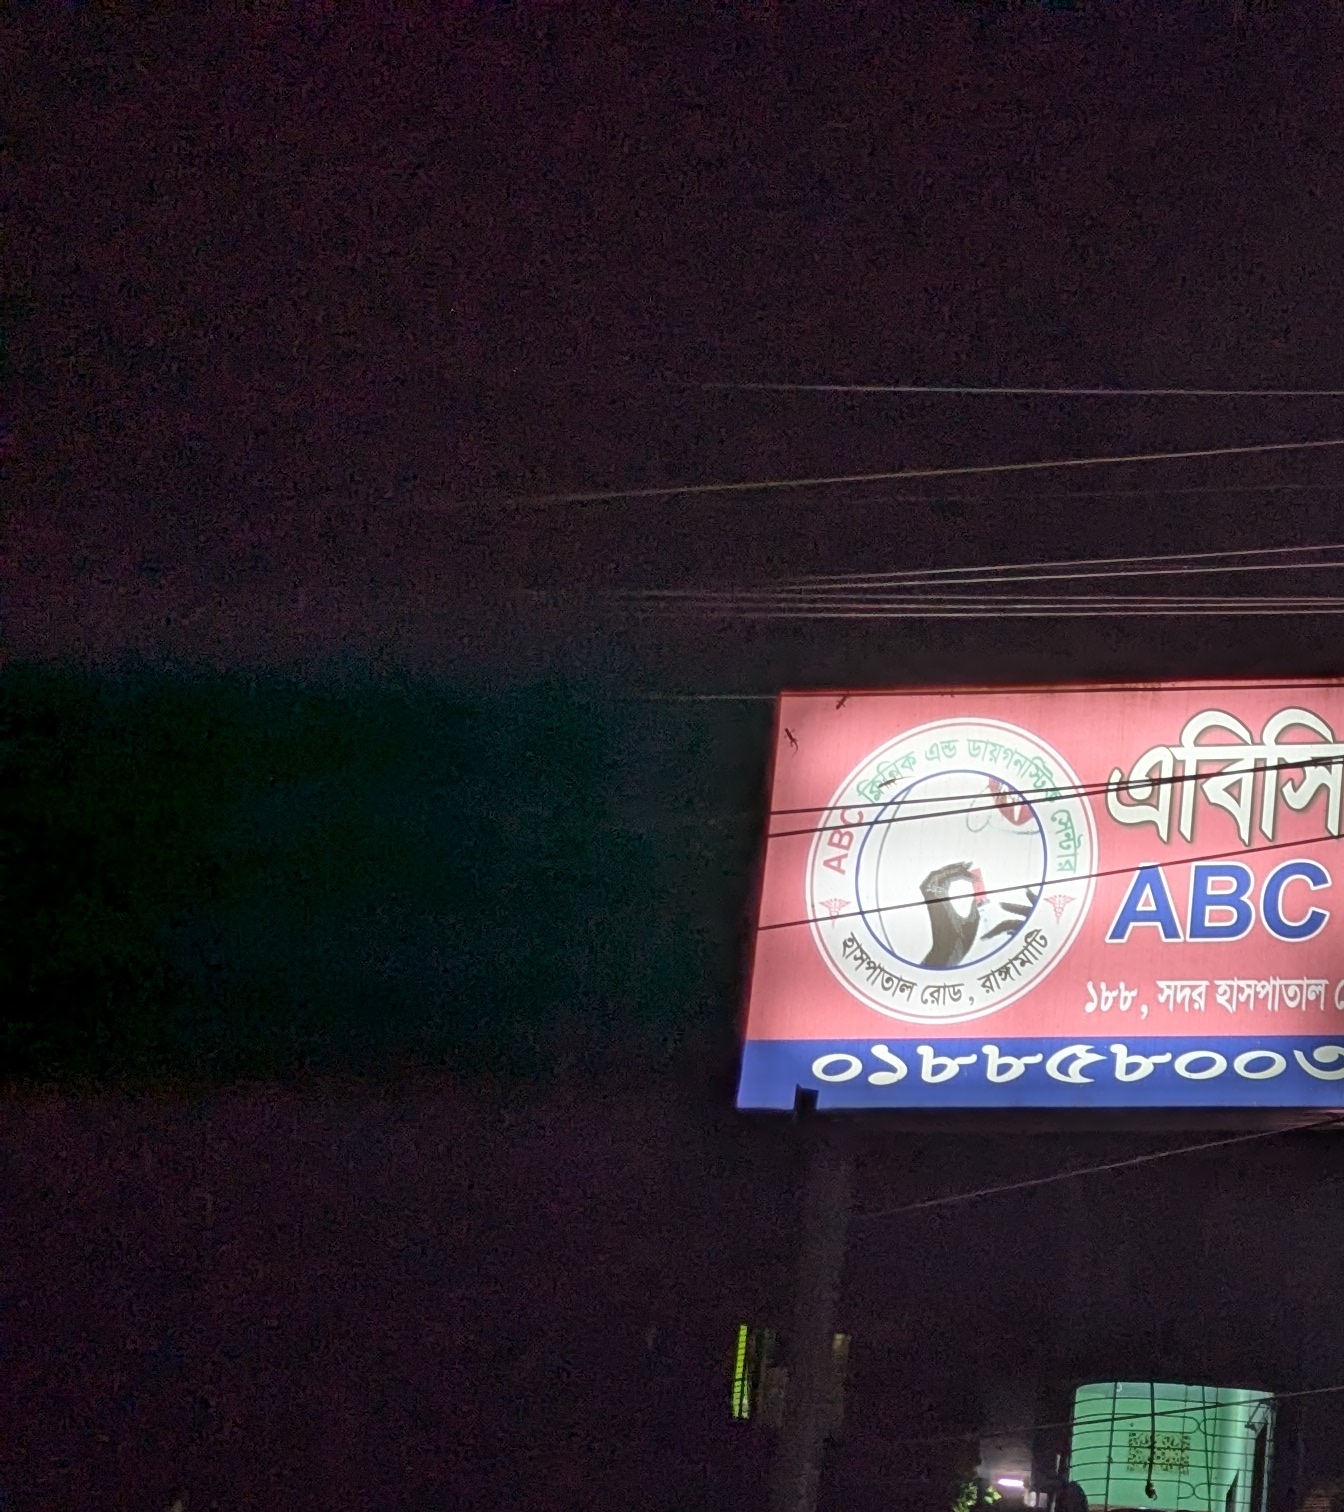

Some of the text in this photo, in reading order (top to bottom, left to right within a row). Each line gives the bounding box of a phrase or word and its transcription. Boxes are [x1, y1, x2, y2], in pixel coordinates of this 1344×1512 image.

[1105, 859, 1331, 942] ABC
[842, 932, 917, 1003] হাসপাতাল
[1156, 979, 1210, 1012] সদর
[1214, 976, 1329, 1013] হাসপাতাল
